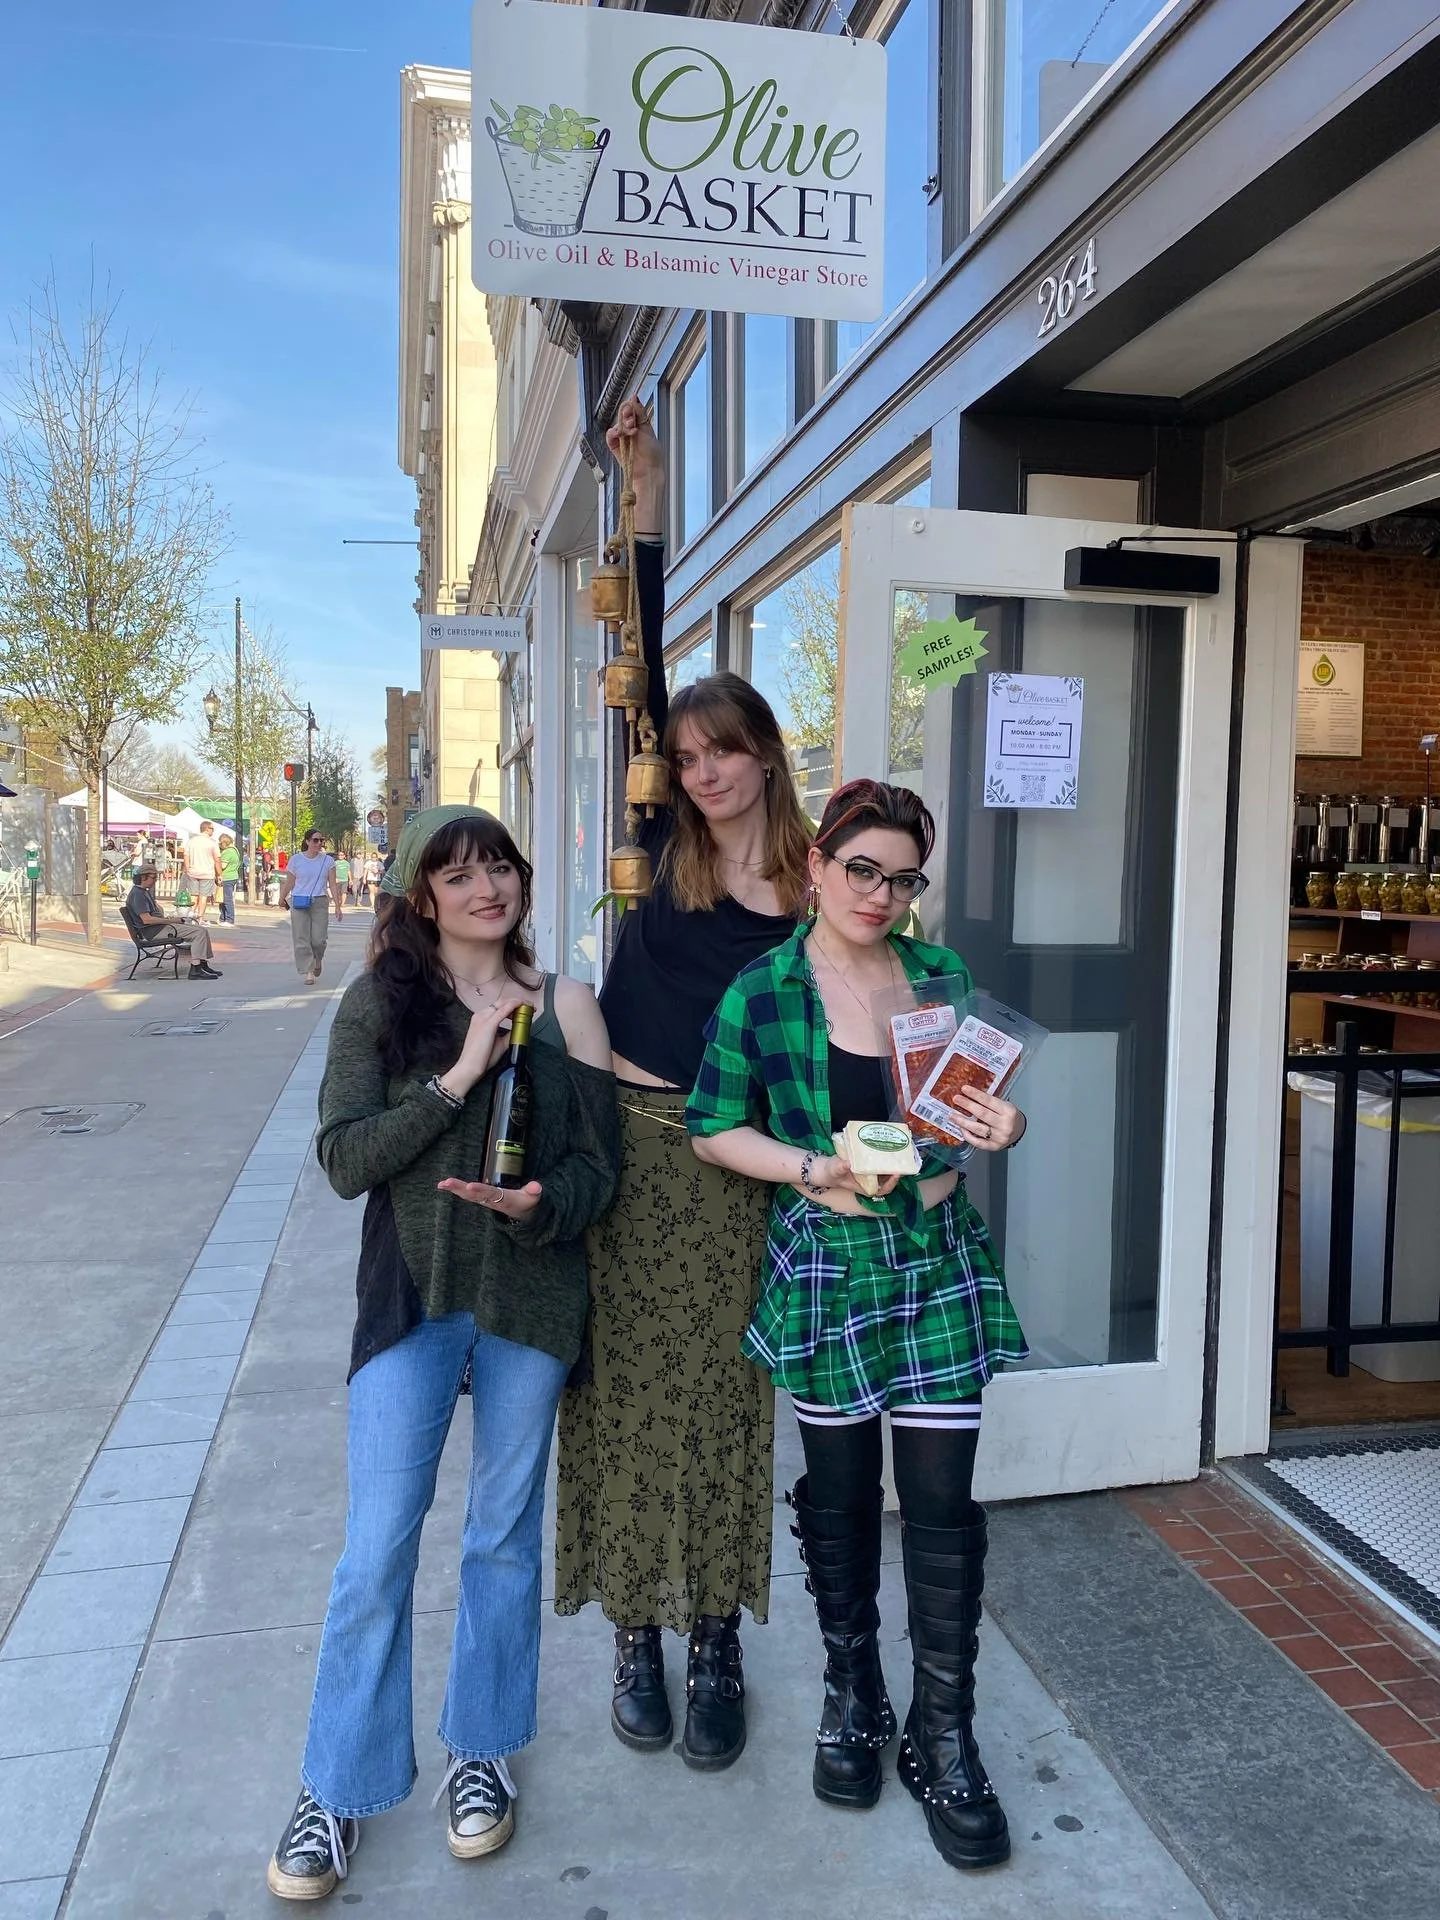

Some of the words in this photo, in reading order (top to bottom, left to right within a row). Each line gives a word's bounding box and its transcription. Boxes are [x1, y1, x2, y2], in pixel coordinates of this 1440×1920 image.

[631, 45, 862, 181] Olive
[612, 169, 872, 244] BASKET
[488, 239, 547, 262] Olive
[556, 243, 589, 265] Oil
[597, 246, 616, 267] &
[624, 248, 720, 274] Balsamic
[728, 257, 810, 286] Vinegar
[817, 265, 868, 287] Store
[1037, 238, 1098, 338] 264
[447, 628, 493, 637] CHRISTOPHER
[494, 630, 521, 638] MOBLEY
[923, 634, 953, 656] FREE
[917, 645, 975, 680] SAMPLES!
[1017, 714, 1056, 727] welcome!
